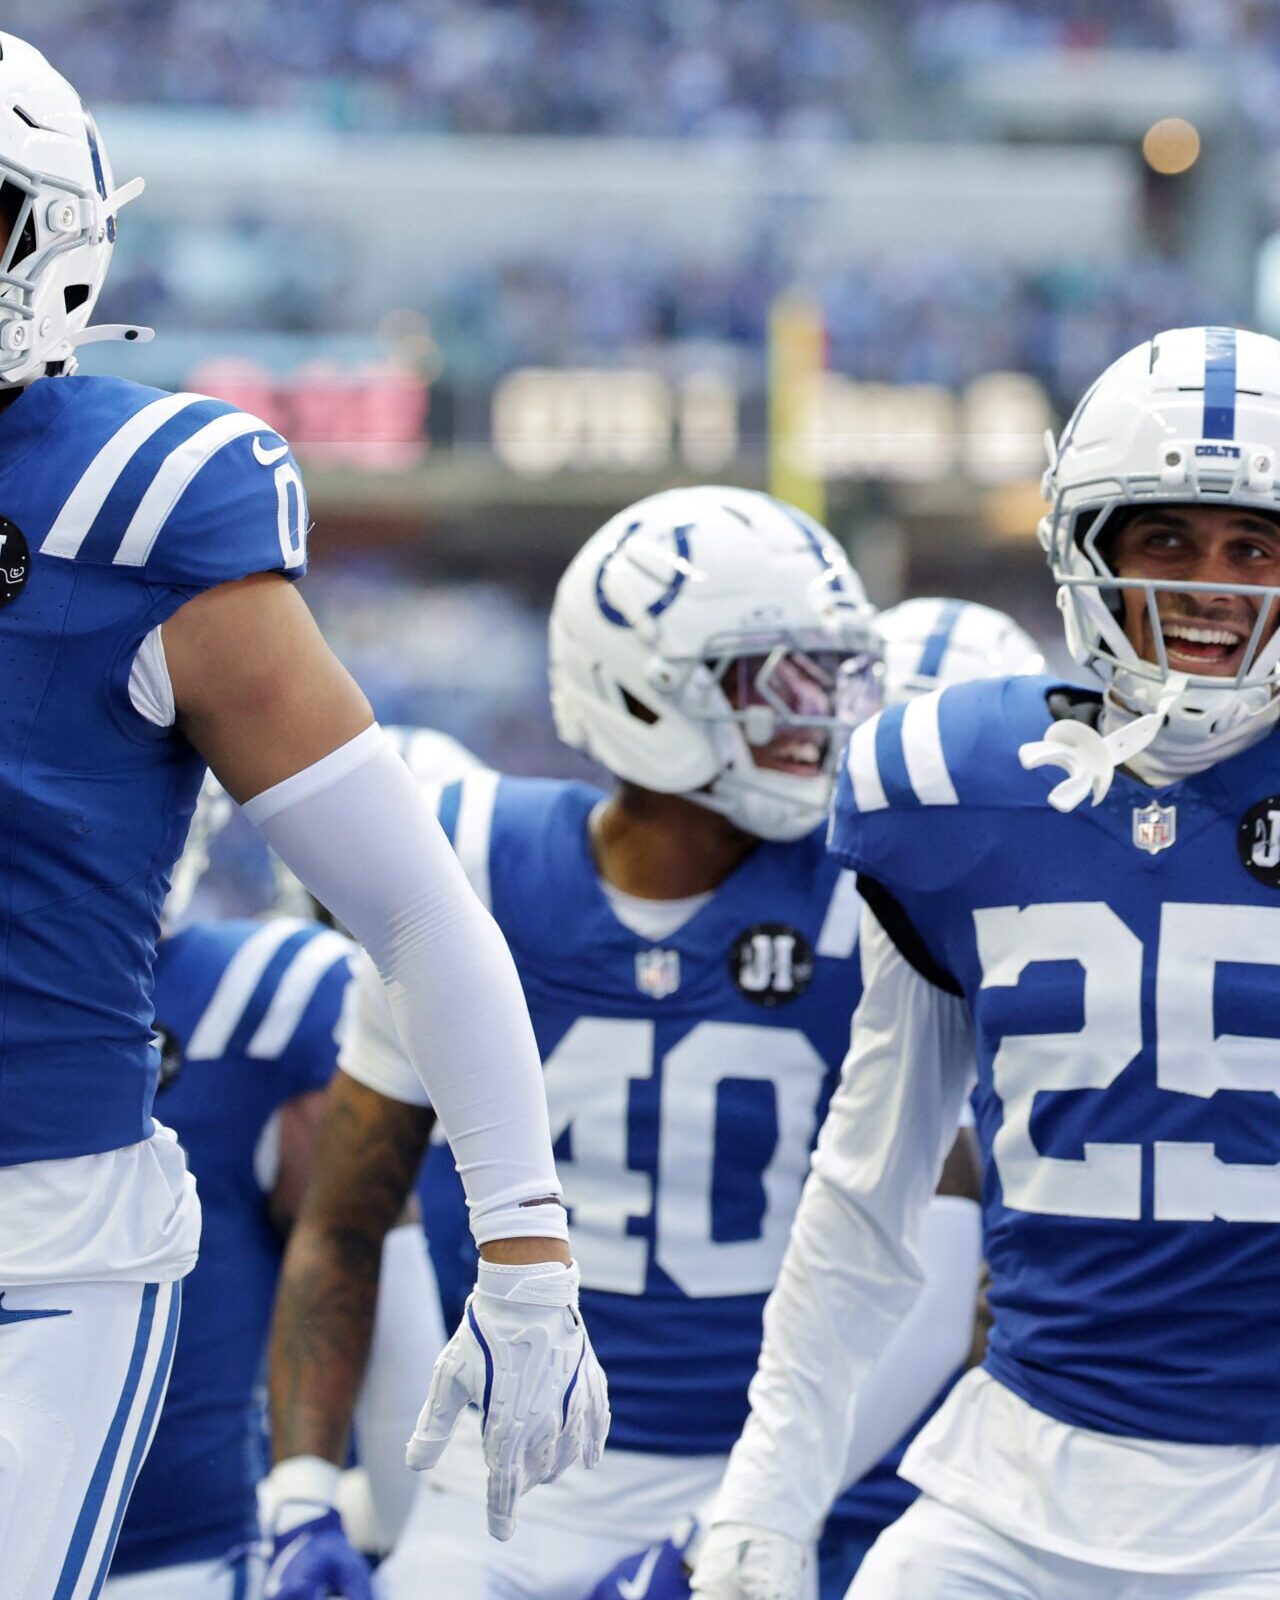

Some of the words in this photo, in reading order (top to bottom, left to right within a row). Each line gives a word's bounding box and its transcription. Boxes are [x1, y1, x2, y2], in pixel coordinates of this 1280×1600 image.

[274, 462, 306, 569] 0
[1195, 445, 1240, 458] COLTS
[541, 1015, 830, 1299] 40
[972, 901, 1280, 1223] 25
